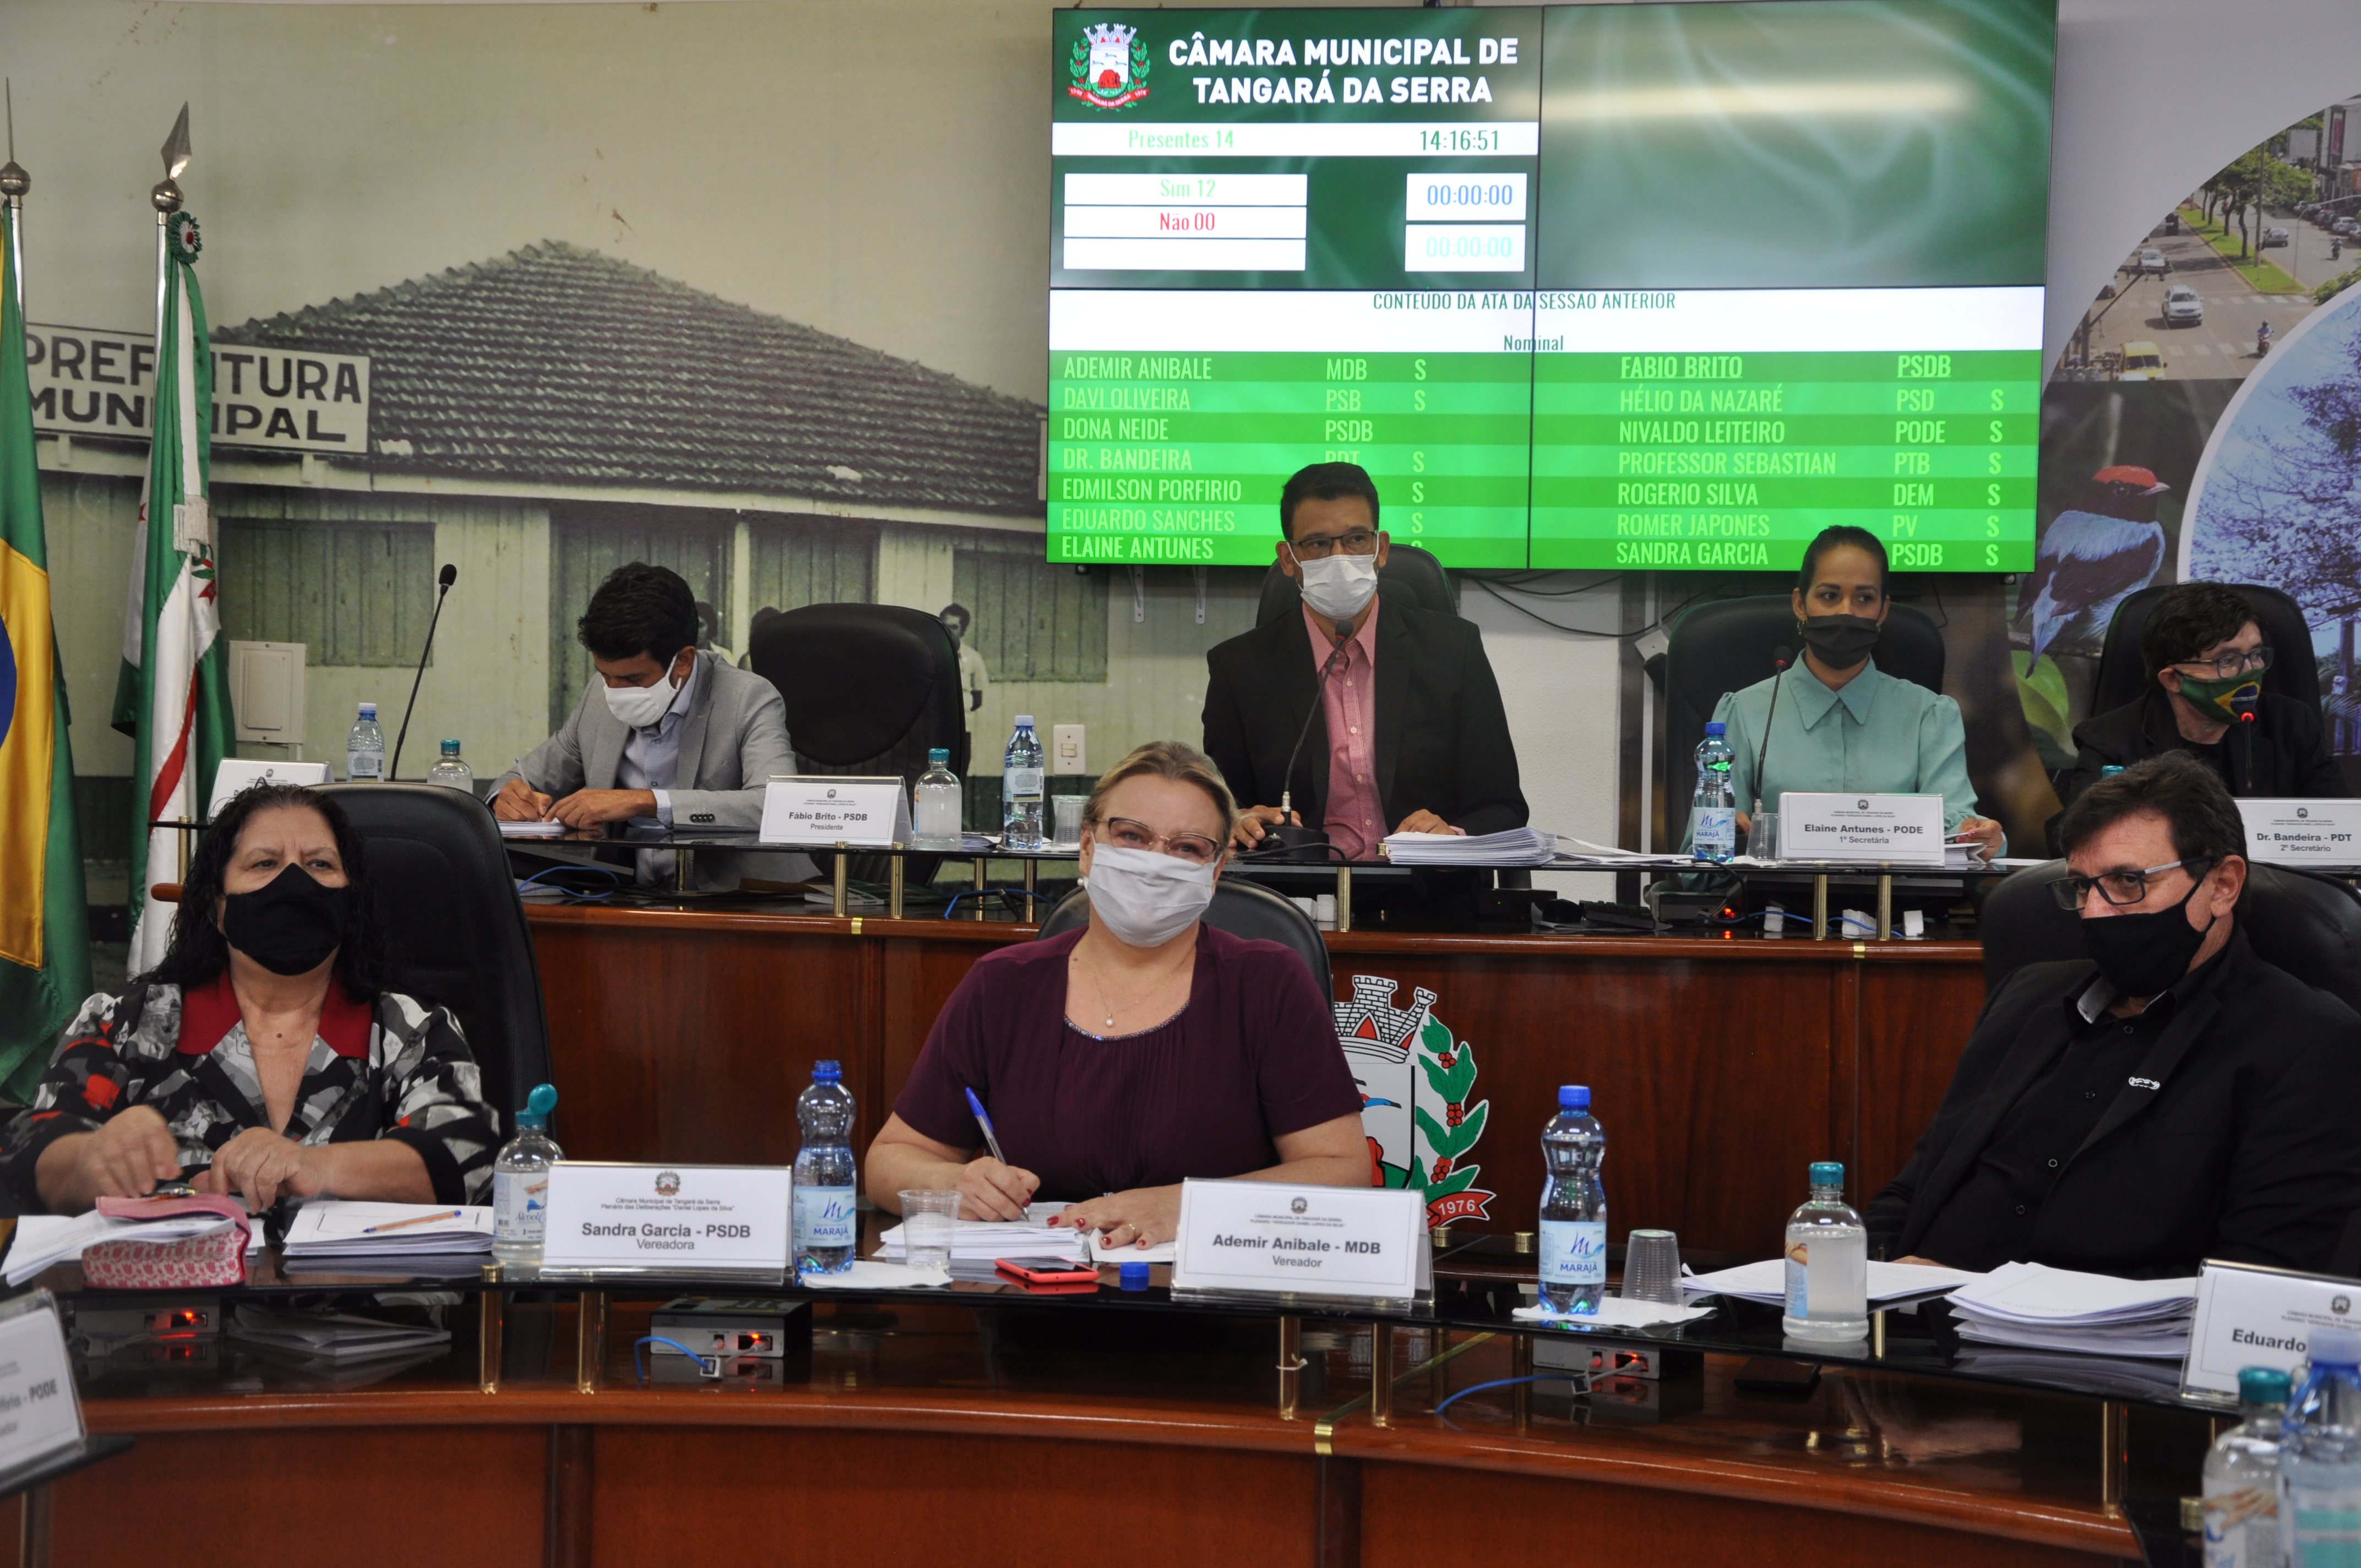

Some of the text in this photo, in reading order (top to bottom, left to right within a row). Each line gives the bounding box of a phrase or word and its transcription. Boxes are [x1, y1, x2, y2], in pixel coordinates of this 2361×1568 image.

[1169, 31, 1518, 66] CÂMARA MUNICIPAL DE
[1193, 69, 1493, 103] TANGARÁ DA SERRA
[1129, 130, 1234, 148] Presentes 14
[1419, 130, 1498, 150] 14:16:51
[1160, 178, 1216, 197] Sim 12
[1427, 185, 1513, 205] 00:00:00
[1194, 212, 1215, 231] 00
[1426, 236, 1511, 257] 00:00:00
[1457, 293, 1476, 309] DA
[1481, 293, 1508, 309] ATA
[1514, 293, 1532, 309] DA
[1602, 292, 1675, 309] ANTERIOR
[1503, 335, 1564, 351] Nominal
[1064, 357, 1212, 379] ADEMIR ANIBALE
[1326, 358, 1367, 380] MDB
[1415, 358, 1427, 380] S
[1620, 356, 1743, 378] FABIO BRITO
[1897, 355, 1951, 378] PSDB
[1063, 387, 1190, 410] DAVI OLIVEIRA
[1325, 389, 1361, 411] PSB
[1414, 389, 1426, 411] S
[1620, 383, 1783, 412] HÉLIO DA NAZARÉ
[1897, 389, 1934, 411] PSD
[1991, 388, 2004, 411] S
[1064, 417, 1168, 440] DONA NEIDE
[1325, 420, 1373, 442] PSDB
[1619, 421, 1785, 443] NIVALDO LEITEIRO
[1896, 420, 1946, 443] PODE
[1990, 420, 2003, 443] S
[1063, 448, 1193, 470] DR. BANDEIRA
[1412, 450, 1424, 472] S
[1619, 451, 1836, 475] PROFESSOR SEBASTIAN
[1895, 452, 1930, 475] PTB
[1989, 451, 2001, 475] S
[1063, 478, 1241, 502] EDMILSON PORFIRIO
[1412, 481, 1424, 503] S
[1618, 482, 1759, 505] ROGERIO SILVA
[1894, 483, 1934, 505] DEM
[1988, 483, 2001, 505] S
[1062, 508, 1235, 531] EDUARDO SANCHES
[1411, 512, 1423, 533] S
[1617, 514, 1770, 536] ROMER JAPONES
[1892, 515, 1918, 537] PV
[1987, 515, 2000, 537] S
[1062, 536, 1214, 559] ELAINE ANTUNES
[1616, 542, 1769, 565] SANDRA GARCIA
[1892, 543, 1943, 565] PSDB
[1985, 543, 1999, 566] S
[789, 812, 813, 820] Fábio
[1804, 824, 1837, 832] Elaine
[1840, 825, 1884, 833] Antunes
[1438, 1199, 1476, 1216] 1976
[581, 1222, 636, 1237] Sandra
[641, 1223, 692, 1238] Garcia
[706, 1224, 750, 1238] PSDB
[814, 1225, 848, 1237] MARAJÁ
[637, 1239, 695, 1250] Vereadora
[1212, 1234, 1268, 1249] Ademir
[1272, 1237, 1330, 1251] Anibale
[1344, 1240, 1380, 1254] MDB
[1272, 1255, 1323, 1267] Vereador
[1560, 1262, 1597, 1273] MARAJÁ
[2232, 1329, 2306, 1352] Eduardo
